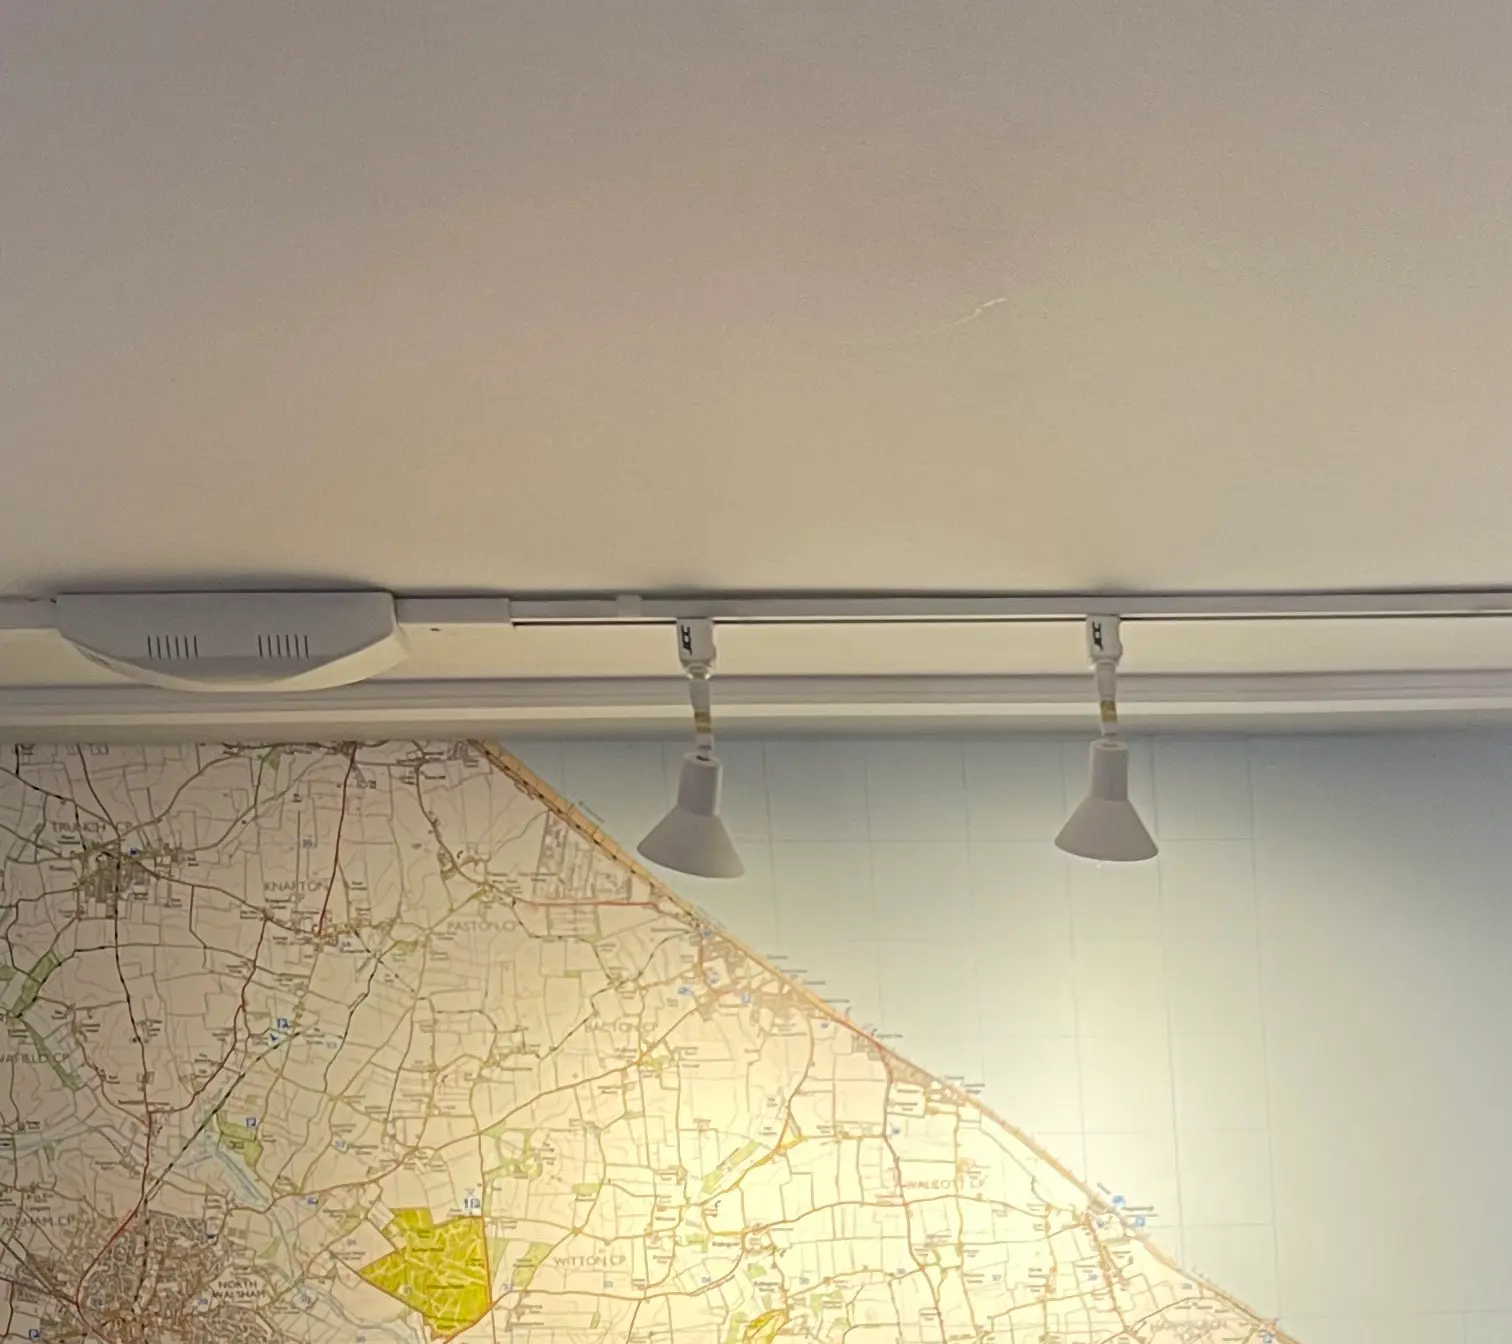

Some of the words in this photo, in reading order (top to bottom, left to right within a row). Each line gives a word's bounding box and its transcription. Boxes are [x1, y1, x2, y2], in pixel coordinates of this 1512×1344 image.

[554, 1255, 606, 1268] WITTON
[217, 1280, 258, 1290] NORTH
[212, 1290, 267, 1300] WALSHAM
